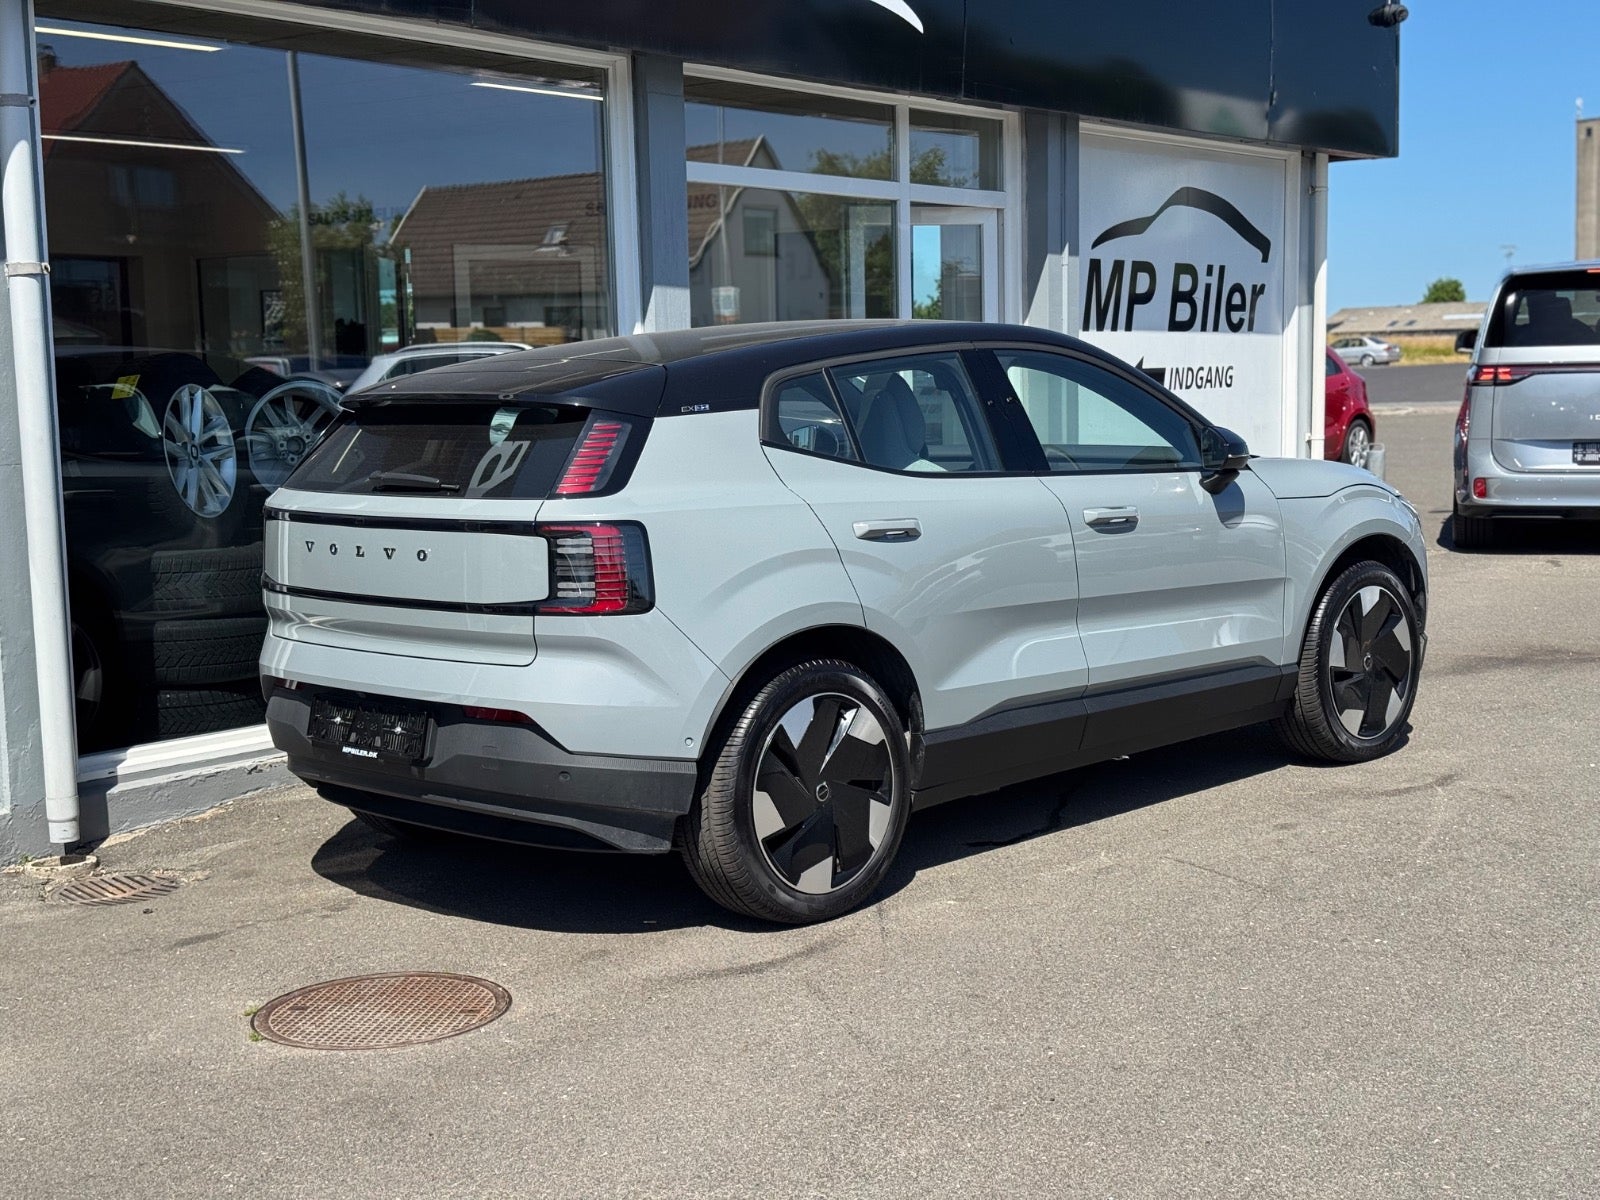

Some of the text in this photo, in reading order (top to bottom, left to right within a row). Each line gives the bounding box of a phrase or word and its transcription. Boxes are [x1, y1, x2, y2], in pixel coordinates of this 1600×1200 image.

[1082, 258, 1266, 333] MP Biler
[1168, 365, 1234, 391] INDGANG
[305, 540, 428, 562] VOLVO
